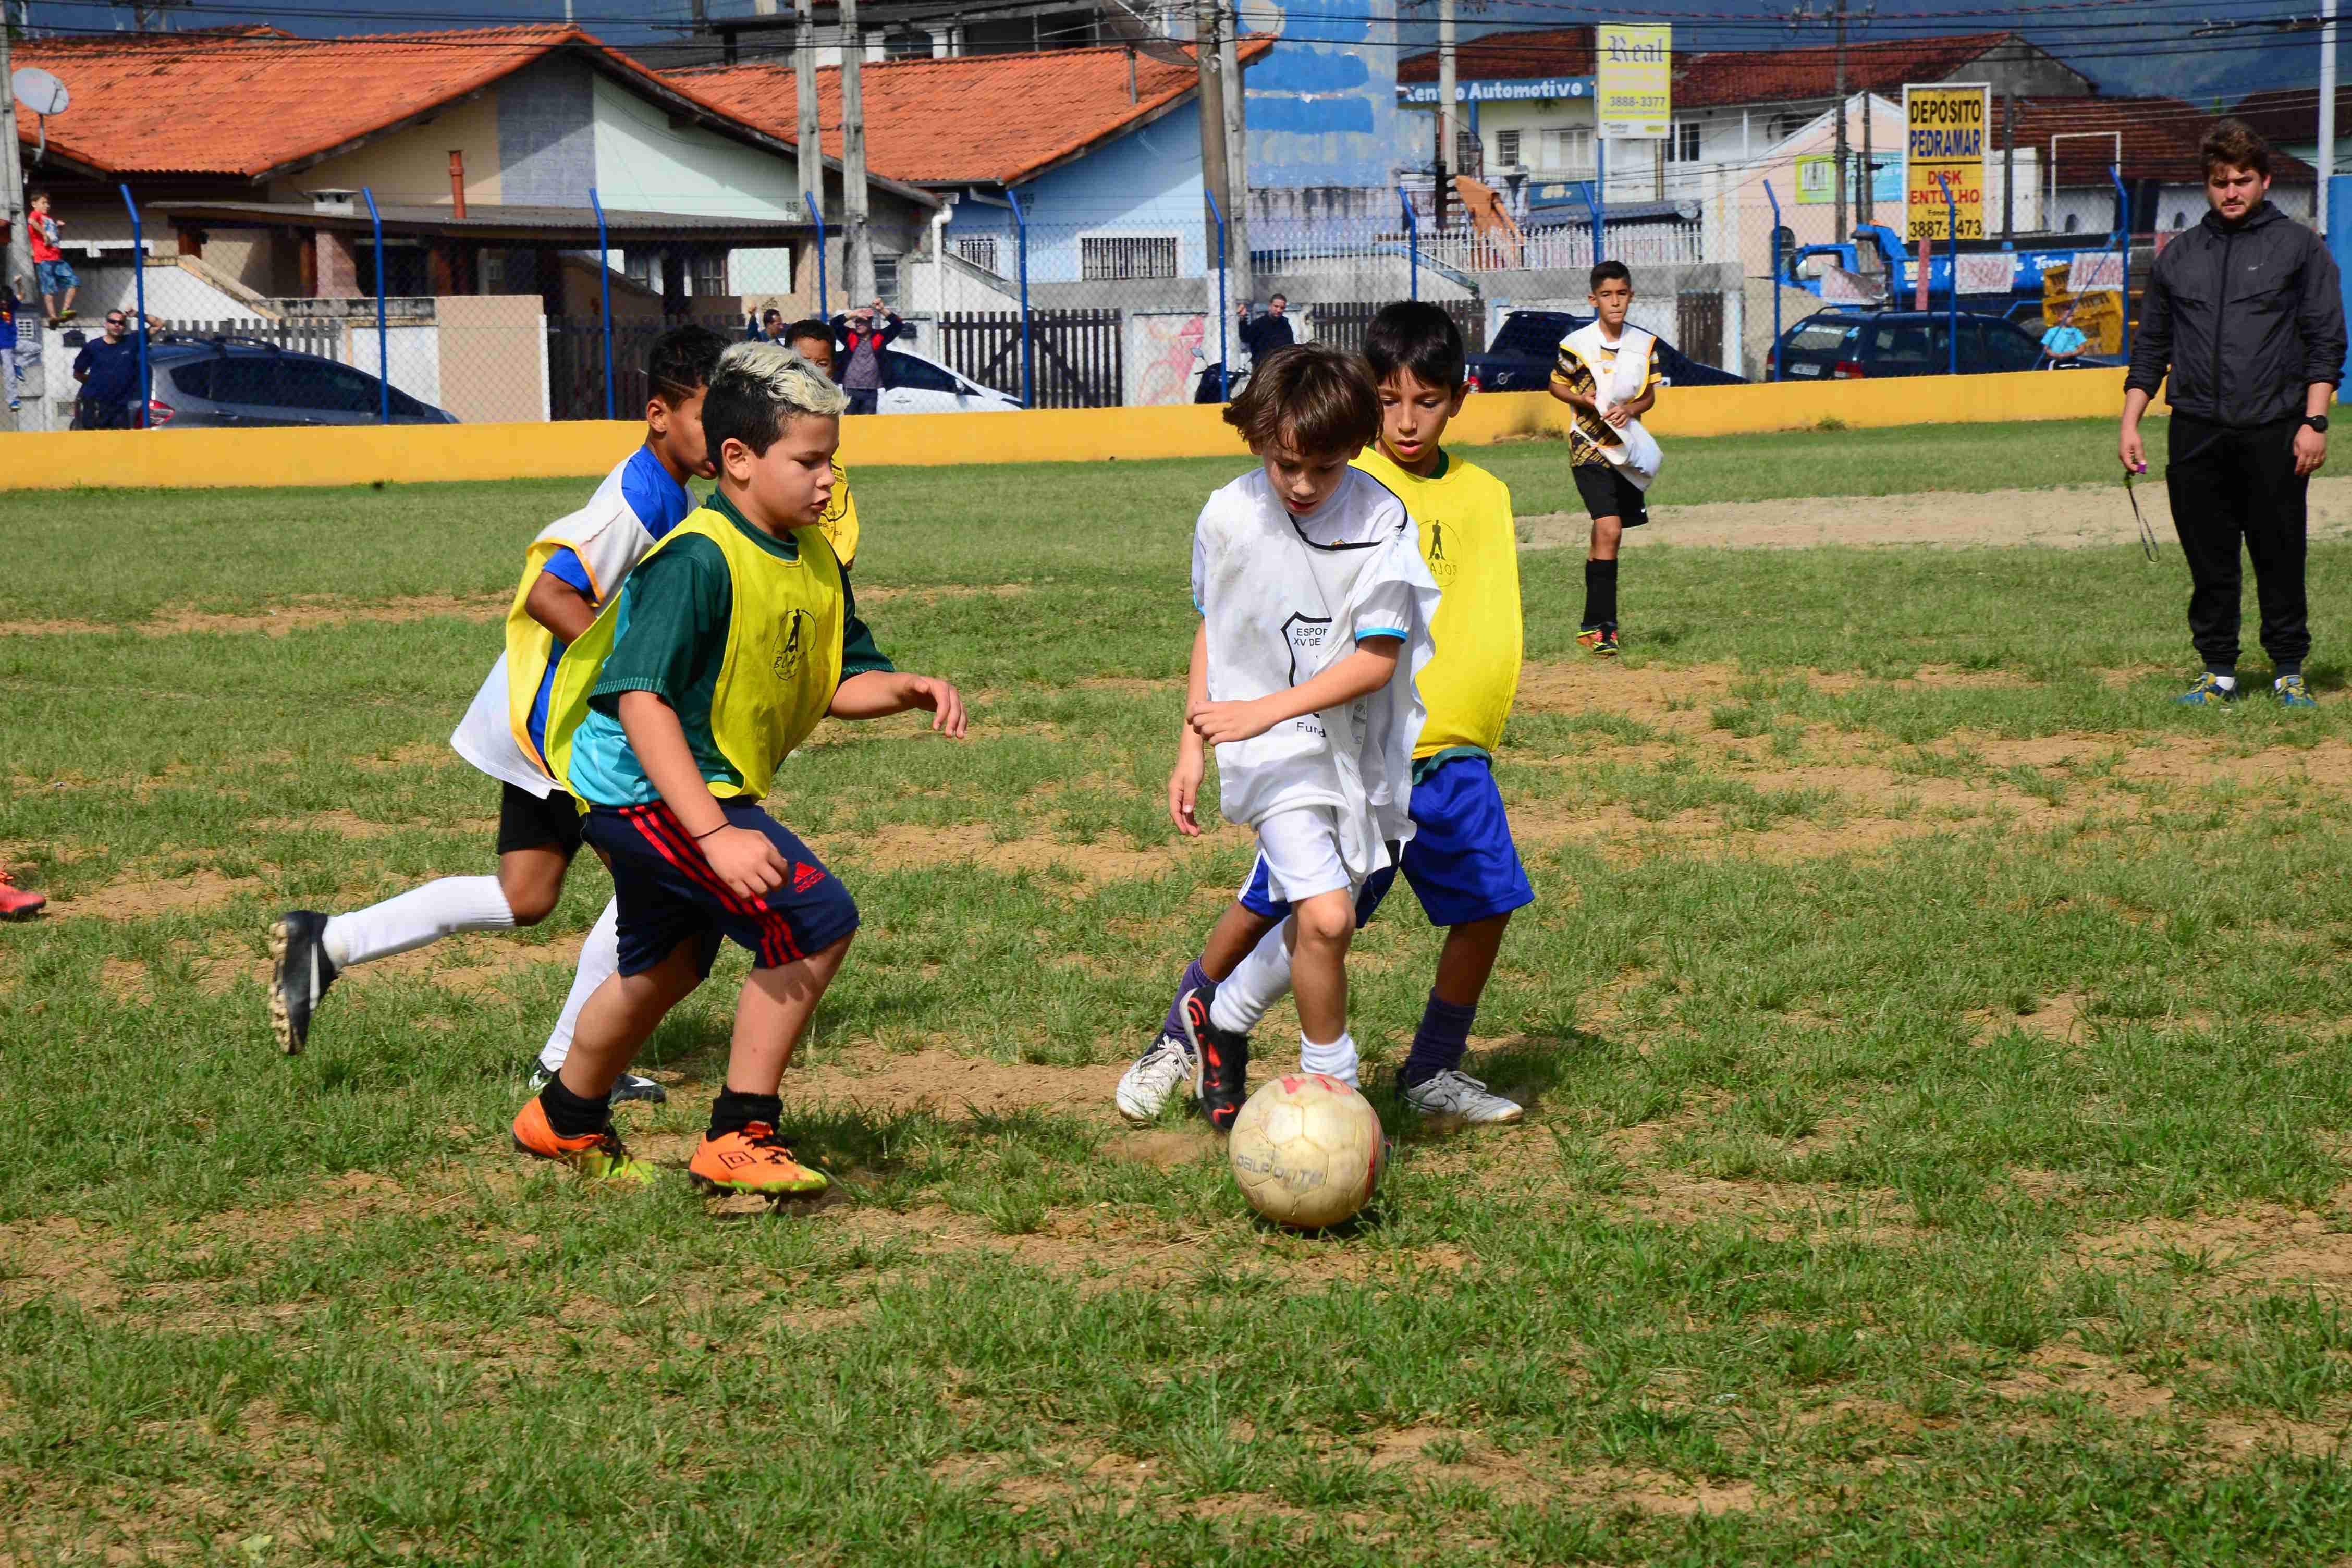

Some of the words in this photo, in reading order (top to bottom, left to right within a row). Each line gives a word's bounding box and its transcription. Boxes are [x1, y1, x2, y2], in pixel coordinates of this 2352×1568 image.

[1608, 35, 1663, 62] Real
[1407, 86, 1464, 101] Ceno
[1468, 80, 1582, 100] Automotivo
[1910, 129, 1980, 156] PEDRAMAR
[1294, 638, 1306, 646] XV
[1309, 638, 1321, 646] DE
